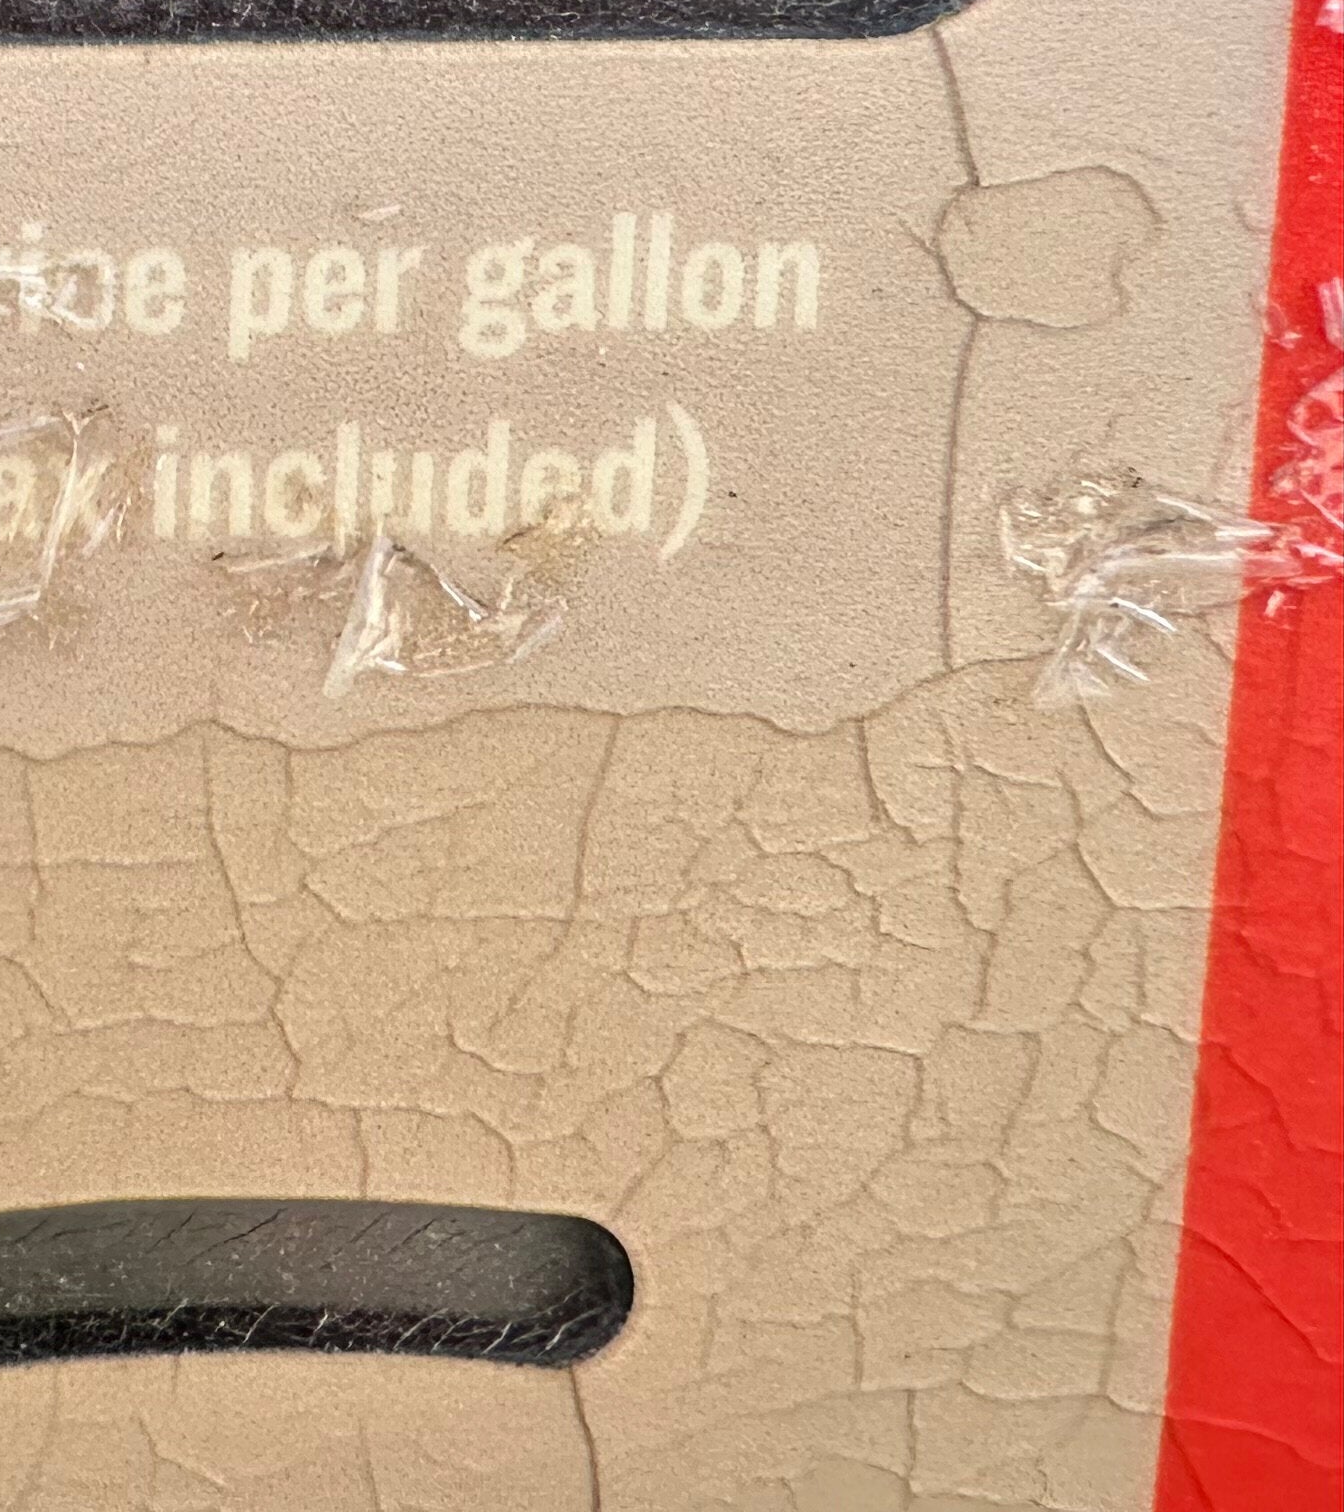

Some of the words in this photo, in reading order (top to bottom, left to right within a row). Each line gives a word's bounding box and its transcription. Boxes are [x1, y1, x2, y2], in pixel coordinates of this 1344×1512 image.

[226, 241, 425, 363] per
[458, 211, 820, 358] gallon
[151, 400, 709, 560] included)
